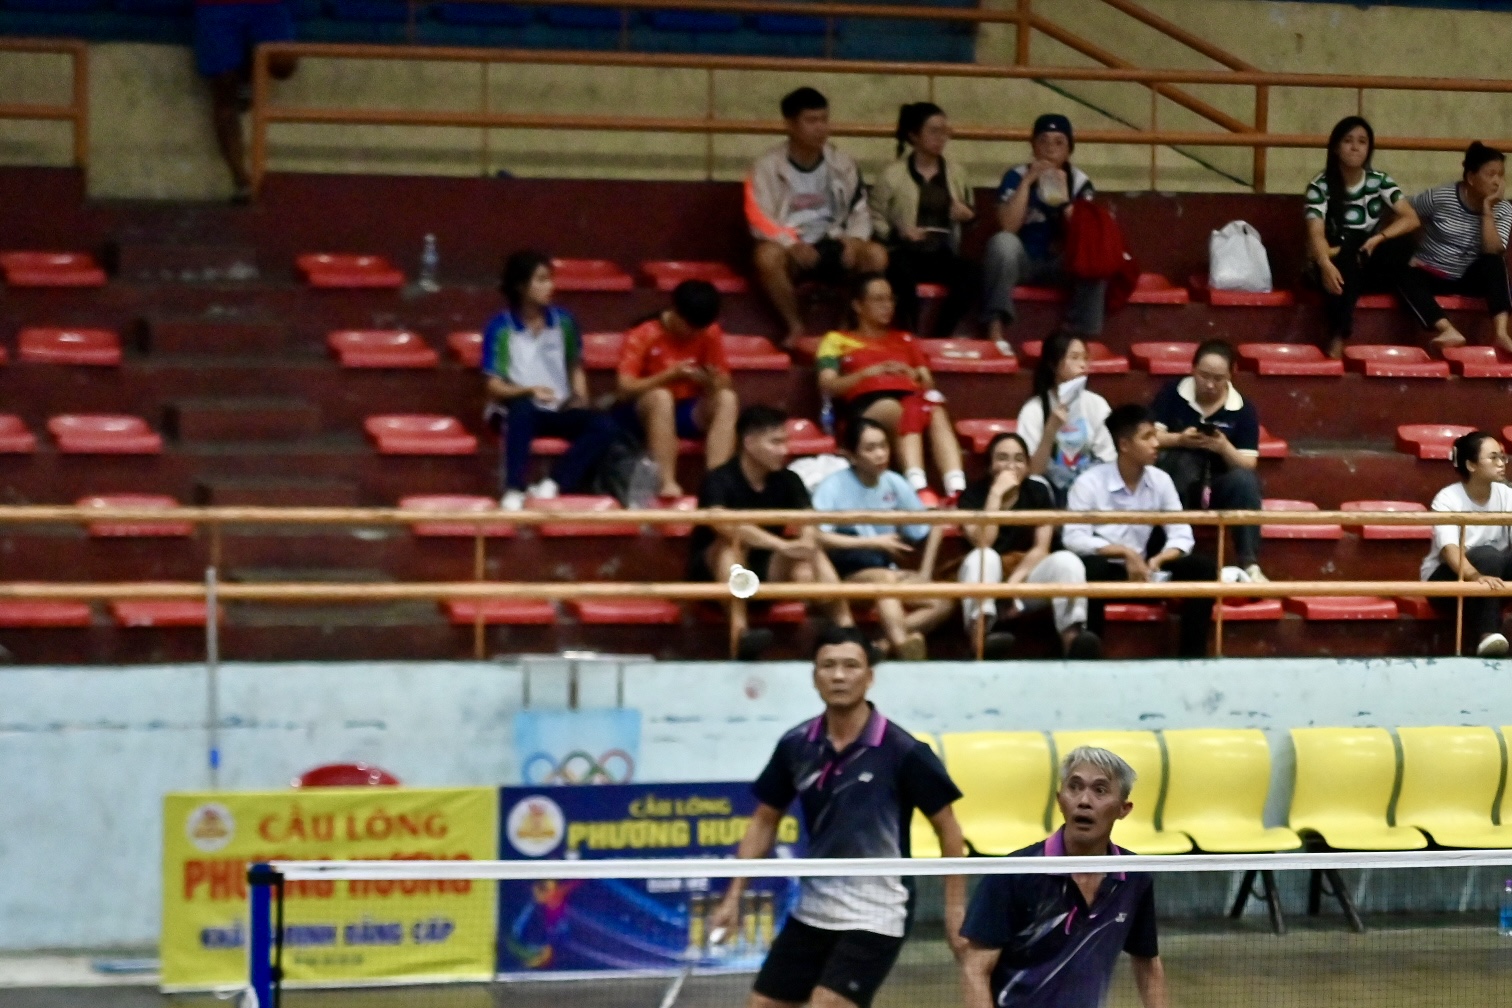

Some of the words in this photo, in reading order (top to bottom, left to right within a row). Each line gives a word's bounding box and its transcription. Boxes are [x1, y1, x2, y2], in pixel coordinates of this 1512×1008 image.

[258, 803, 335, 842] CẦU
[347, 807, 448, 841] LÔNG
[567, 818, 690, 850] PHƯƠNG
[697, 815, 799, 846] HƯƠG
